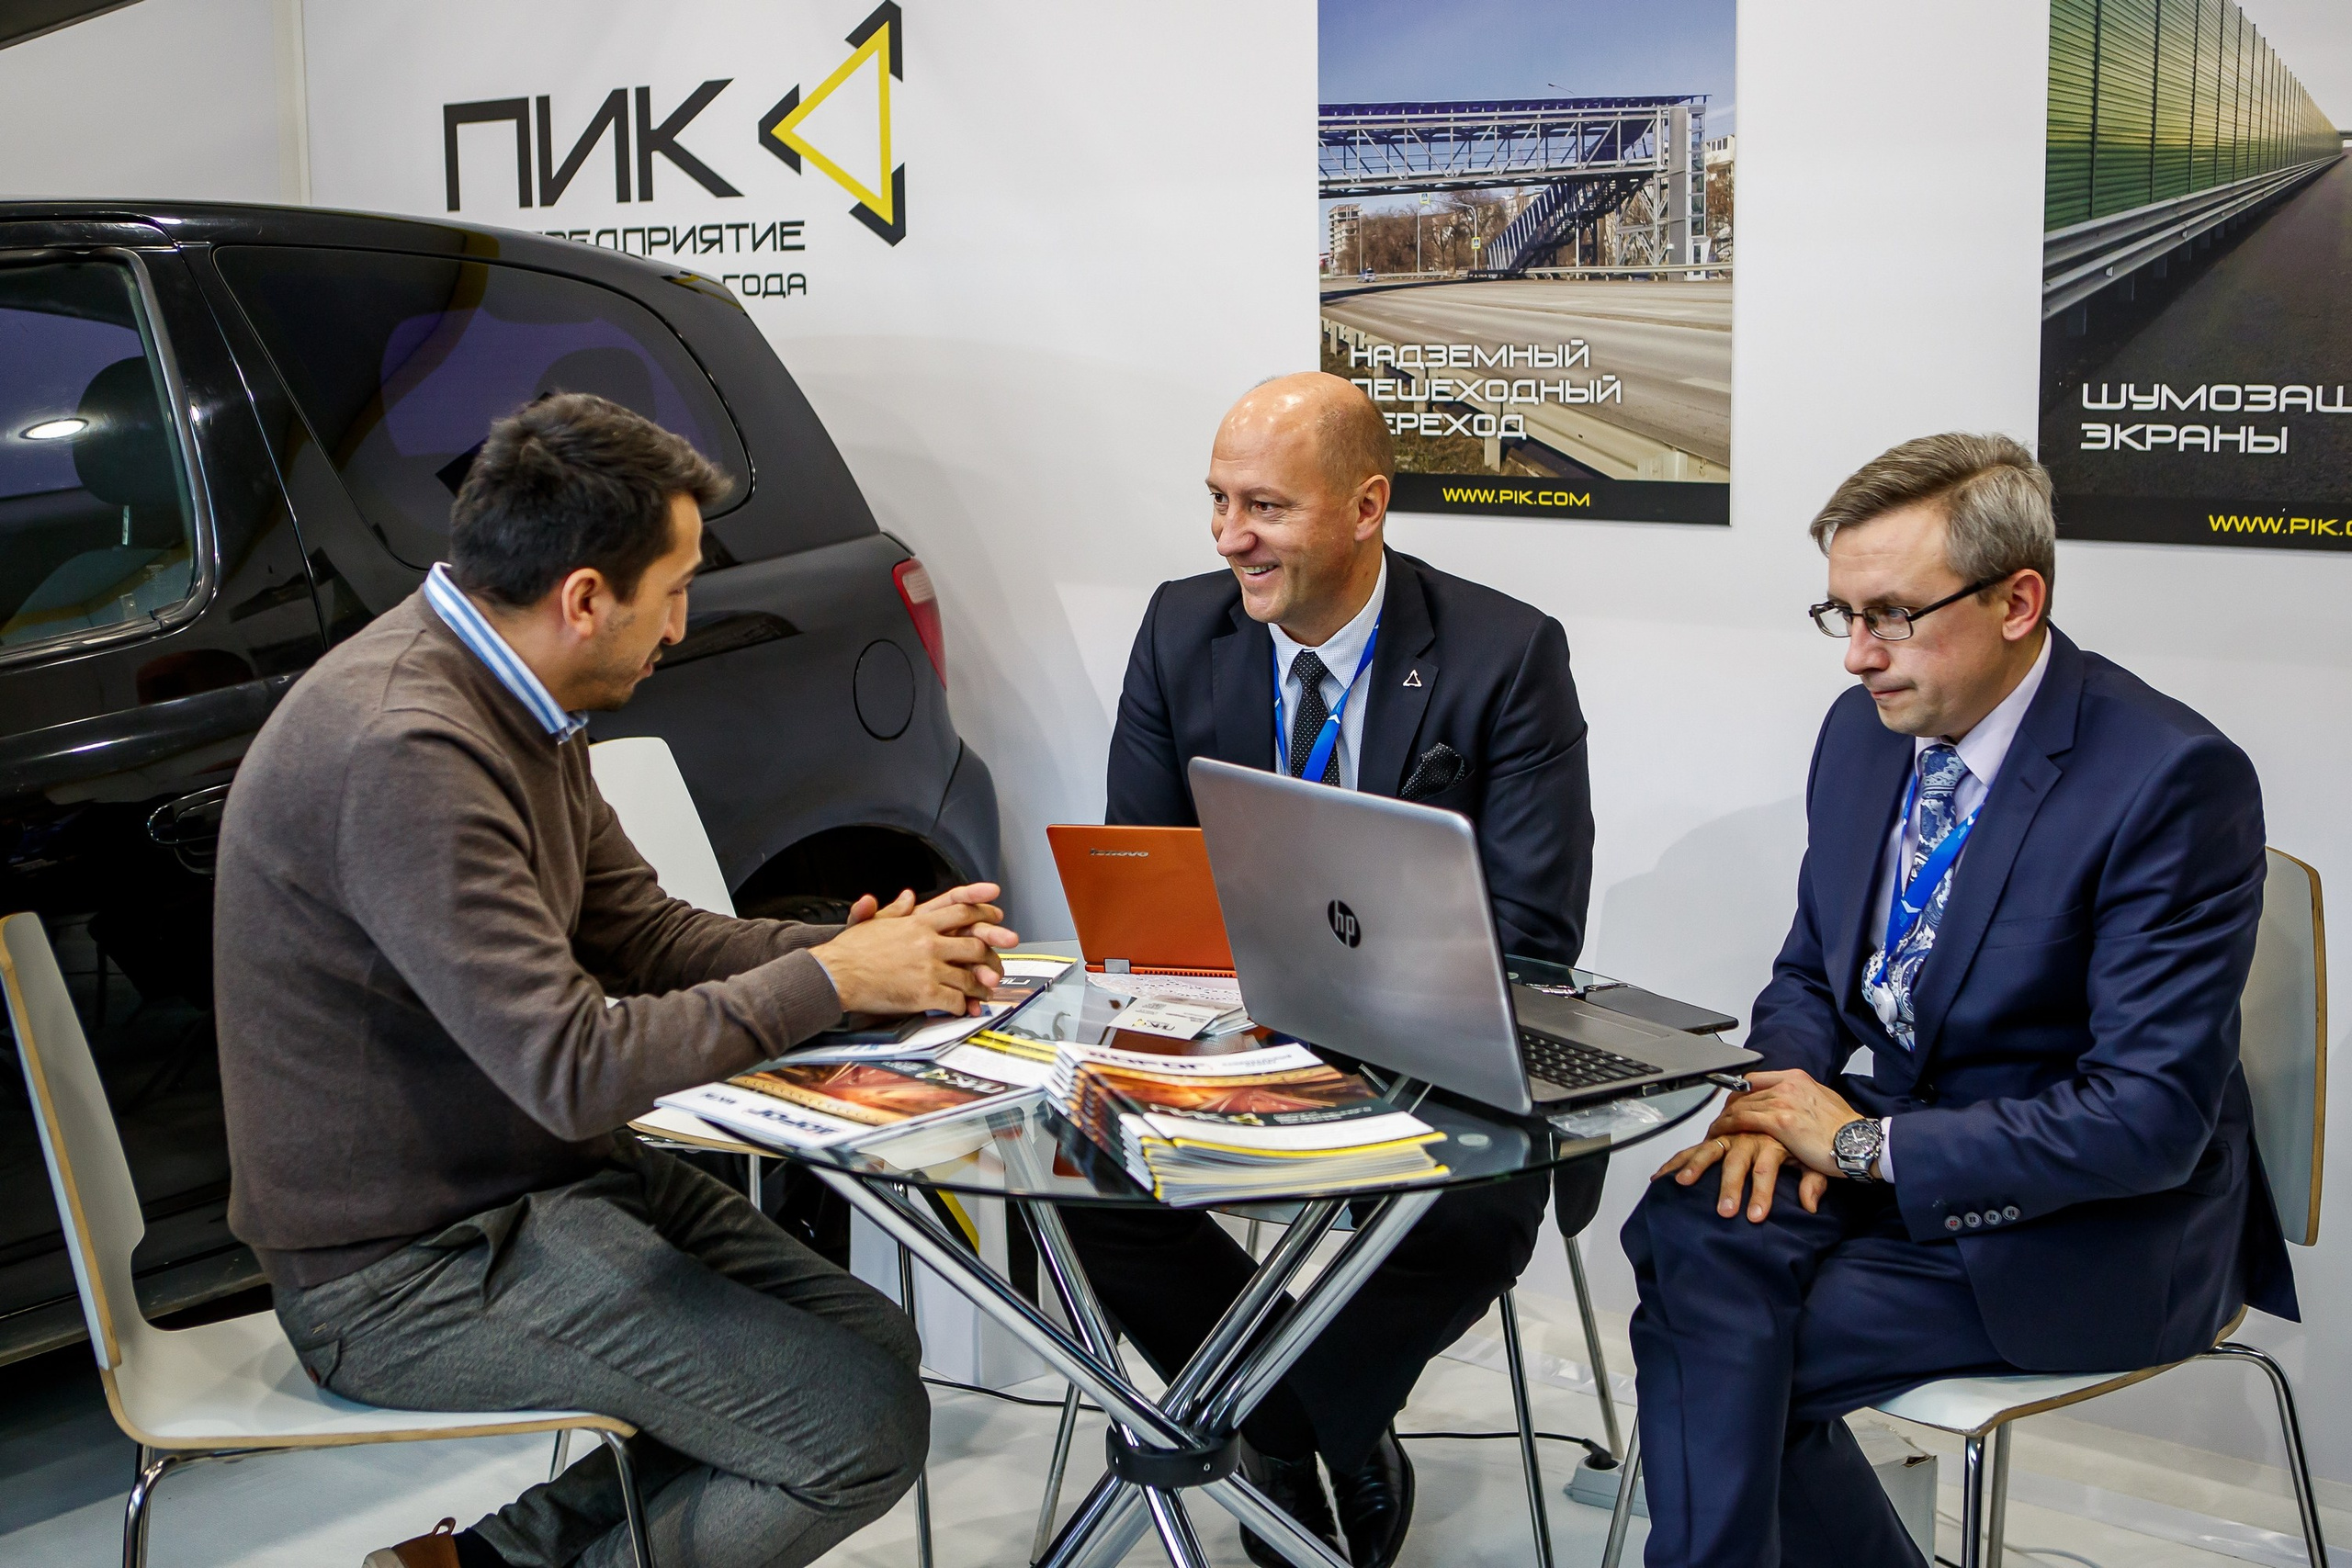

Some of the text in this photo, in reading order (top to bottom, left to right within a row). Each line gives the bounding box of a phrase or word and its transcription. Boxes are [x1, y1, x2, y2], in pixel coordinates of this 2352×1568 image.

[443, 77, 745, 212] ПИК
[1350, 339, 1590, 370] НАДЗЕМНЫЙ
[1383, 412, 1527, 441] ЕРЕХОД
[2080, 423, 2288, 454] ЭКРАНЫ
[1442, 487, 1590, 508] WWW.PIK.COM
[1334, 900, 1355, 946] hp
